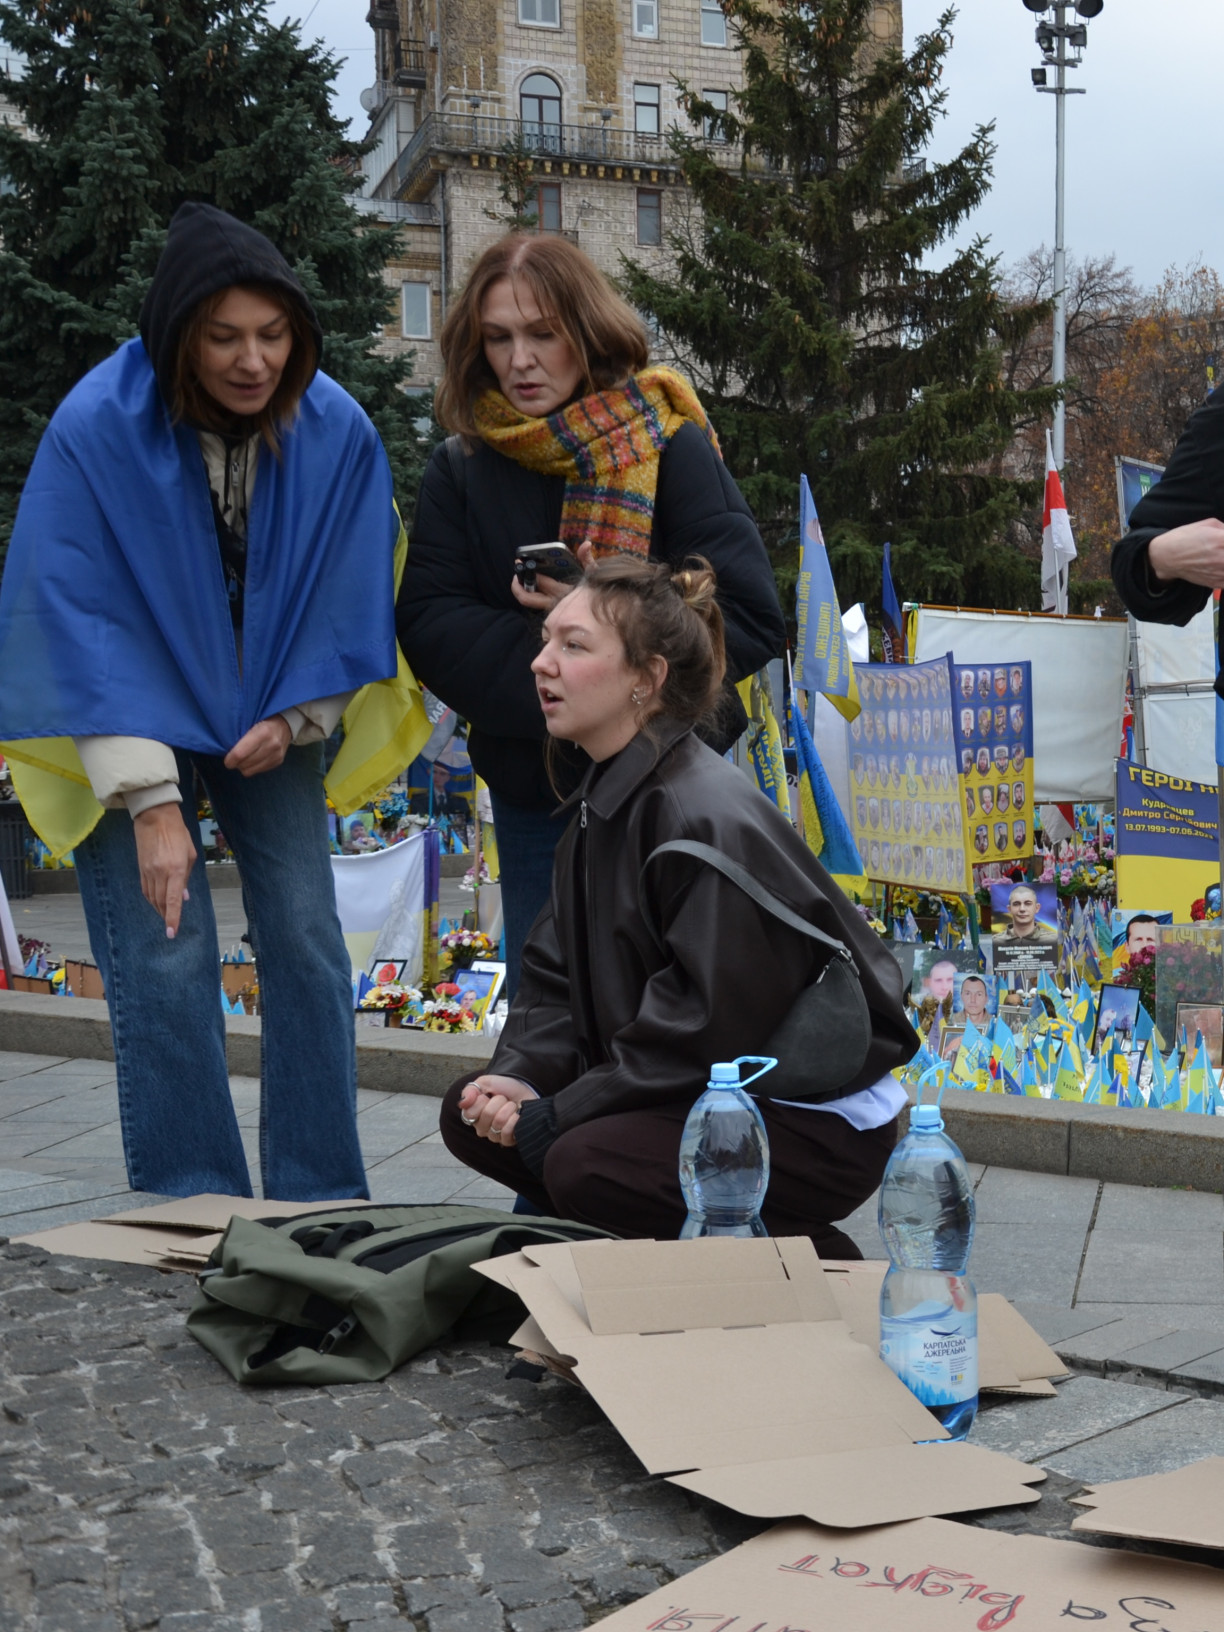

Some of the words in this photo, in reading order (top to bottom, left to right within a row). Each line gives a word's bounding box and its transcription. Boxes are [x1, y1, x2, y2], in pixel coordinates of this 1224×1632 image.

[1128, 766, 1193, 792] ГЕРОЇ
[1122, 808, 1161, 820] Дмитро
[923, 1338, 967, 1350] КАРПАТСЬКА
[924, 1346, 967, 1358] ДЖЕРЕЛЬНА
